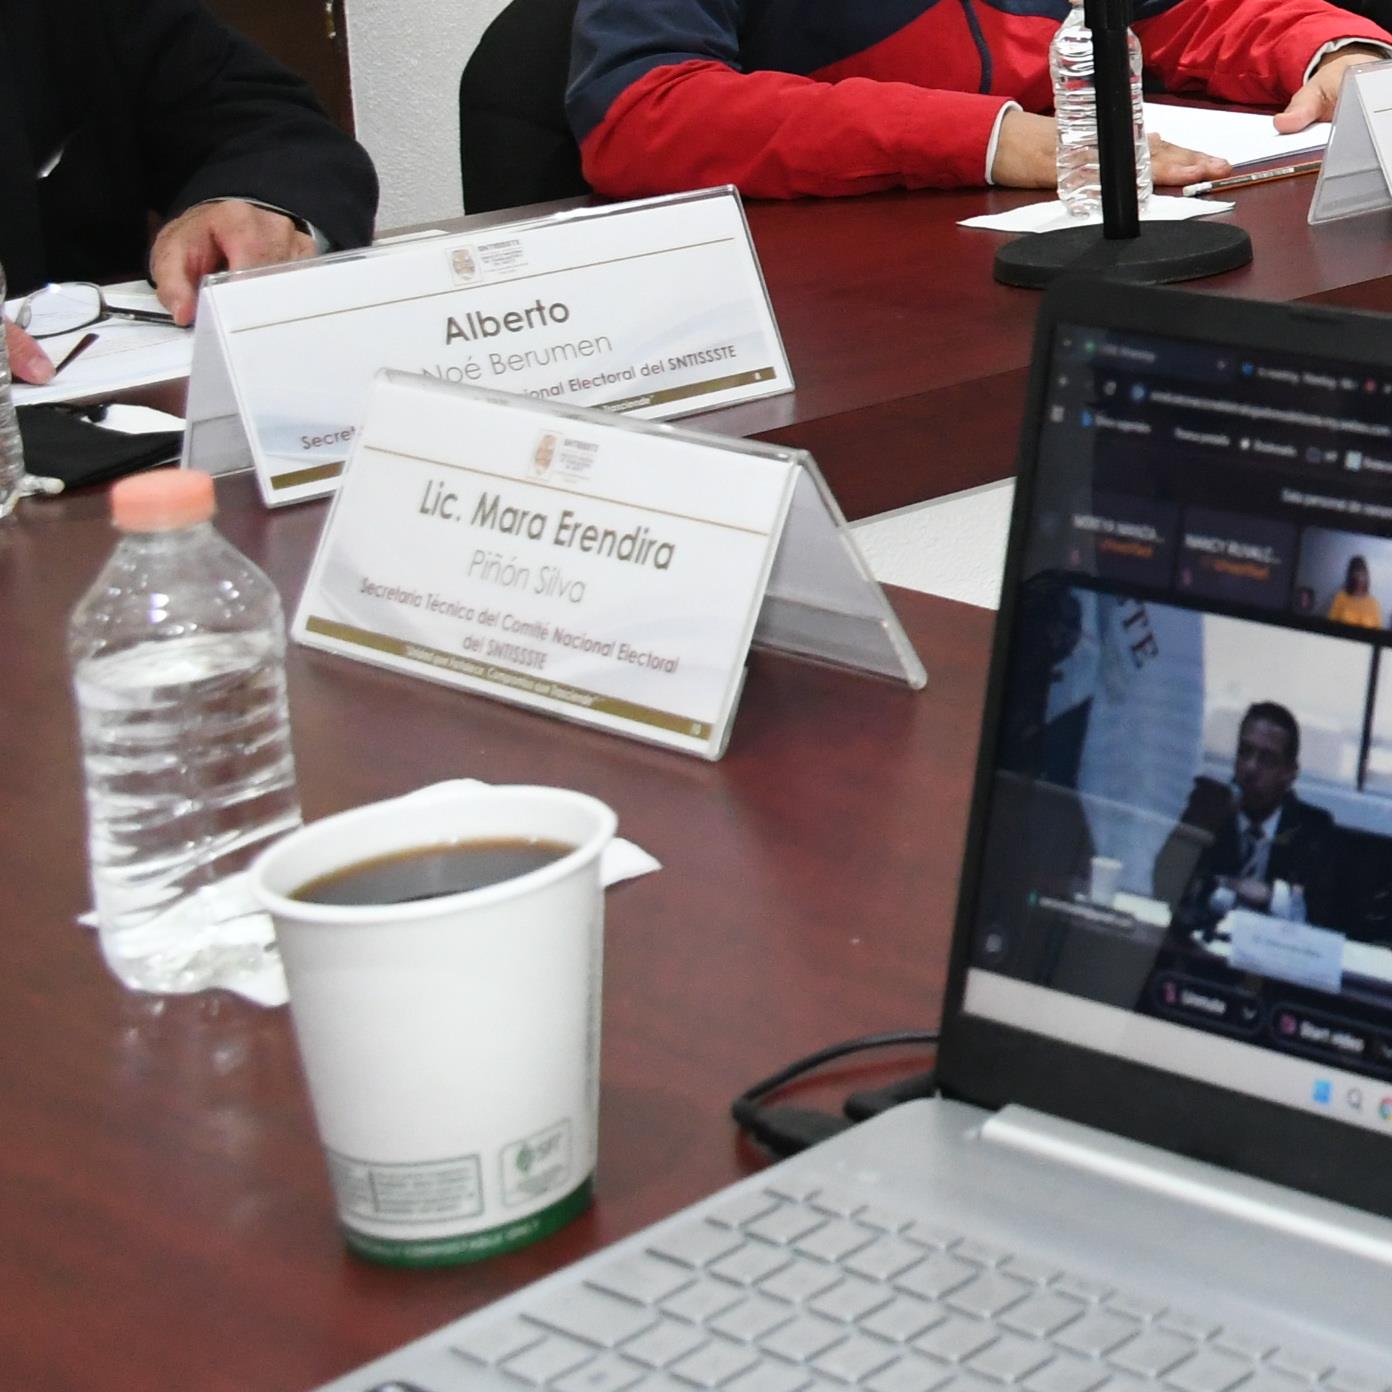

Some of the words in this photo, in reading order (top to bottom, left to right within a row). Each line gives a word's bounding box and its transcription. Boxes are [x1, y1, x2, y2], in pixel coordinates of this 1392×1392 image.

[444, 298, 571, 346] Alberto
[489, 333, 613, 376] Berumen
[568, 365, 636, 392] Electoral
[639, 358, 666, 377] del
[667, 344, 738, 370] SNTISSSTE
[417, 479, 461, 522] Lic.
[471, 490, 548, 541] Mara
[553, 510, 677, 571] Erendira
[467, 549, 531, 591] Piñón
[533, 565, 587, 604] Silva
[425, 592, 475, 622] Técnica
[477, 606, 500, 628] del
[502, 612, 550, 641] Comité
[552, 626, 616, 659] Nacional
[617, 642, 680, 675] Electoral
[463, 633, 486, 654] del
